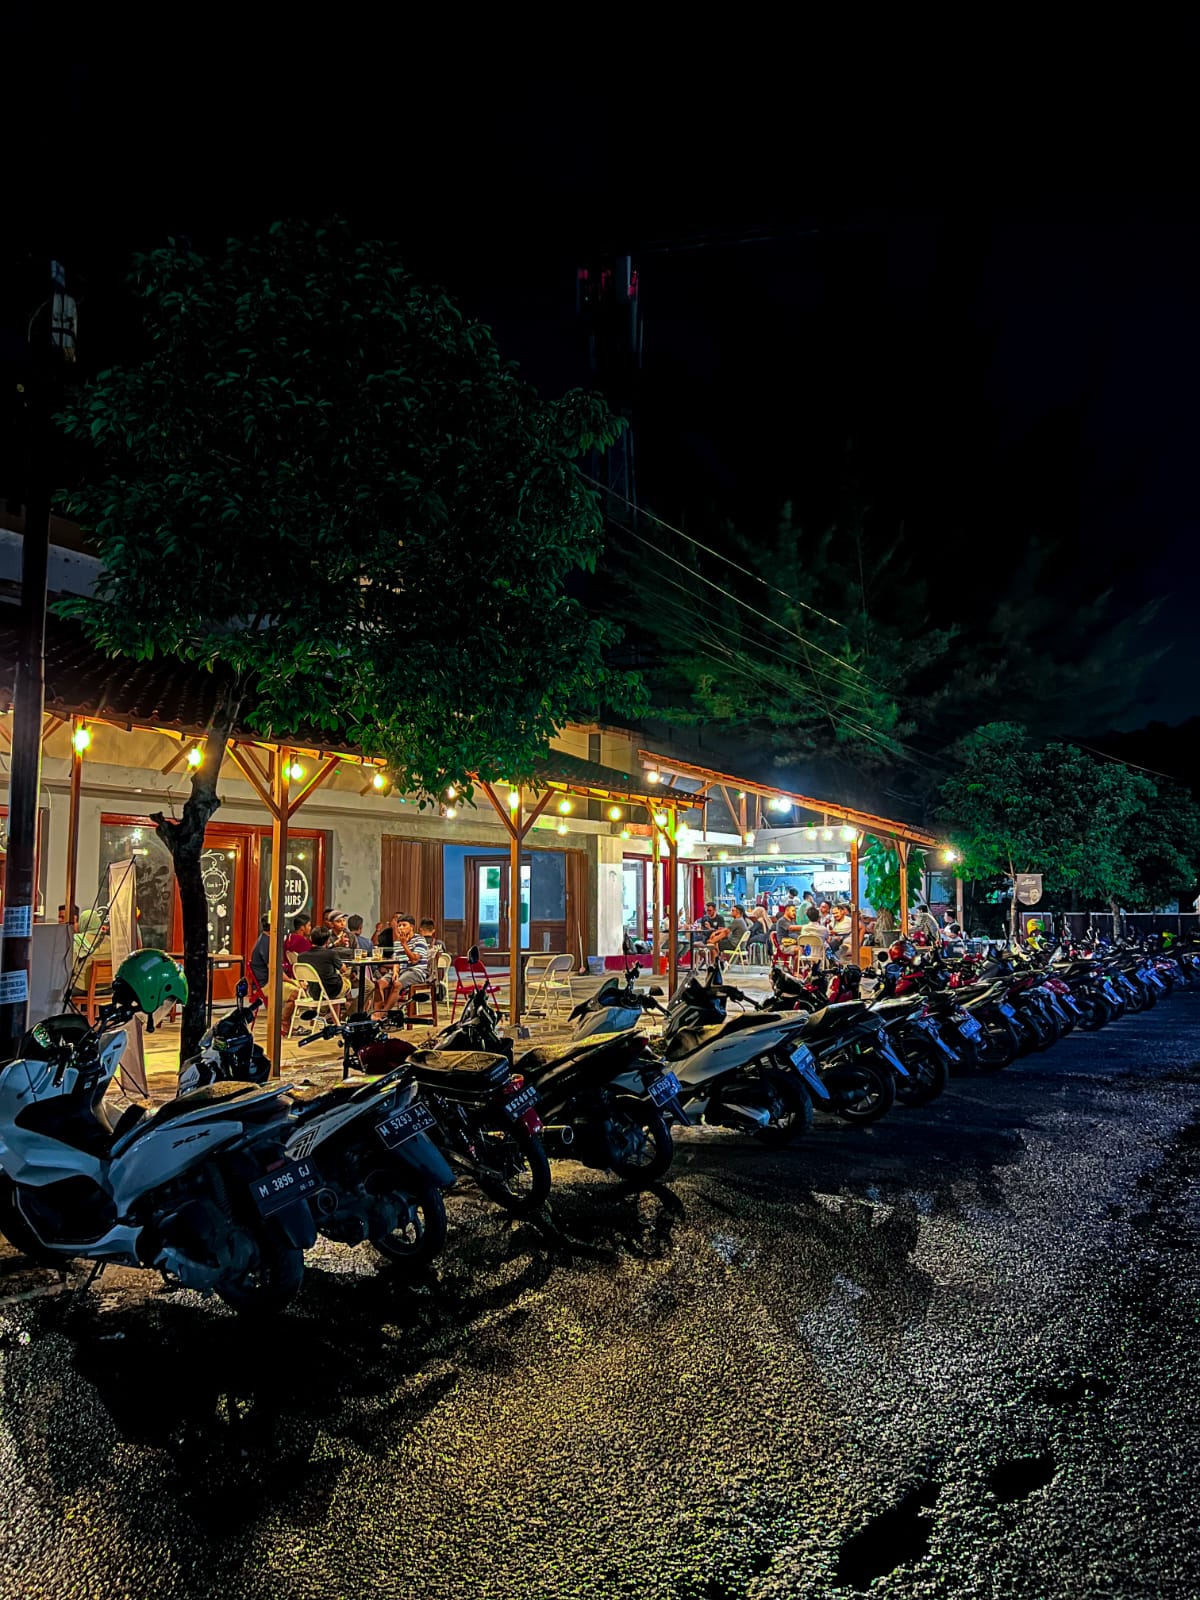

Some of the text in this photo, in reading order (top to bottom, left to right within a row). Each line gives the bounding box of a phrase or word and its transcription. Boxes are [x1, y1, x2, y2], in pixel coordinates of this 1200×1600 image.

[285, 879, 302, 893] PEN
[285, 895, 302, 906] OURS
[390, 1112, 413, 1130] 5293
[413, 1105, 427, 1118] AA
[170, 1128, 211, 1149] PCX
[258, 1163, 310, 1198] M 3896 GJ
